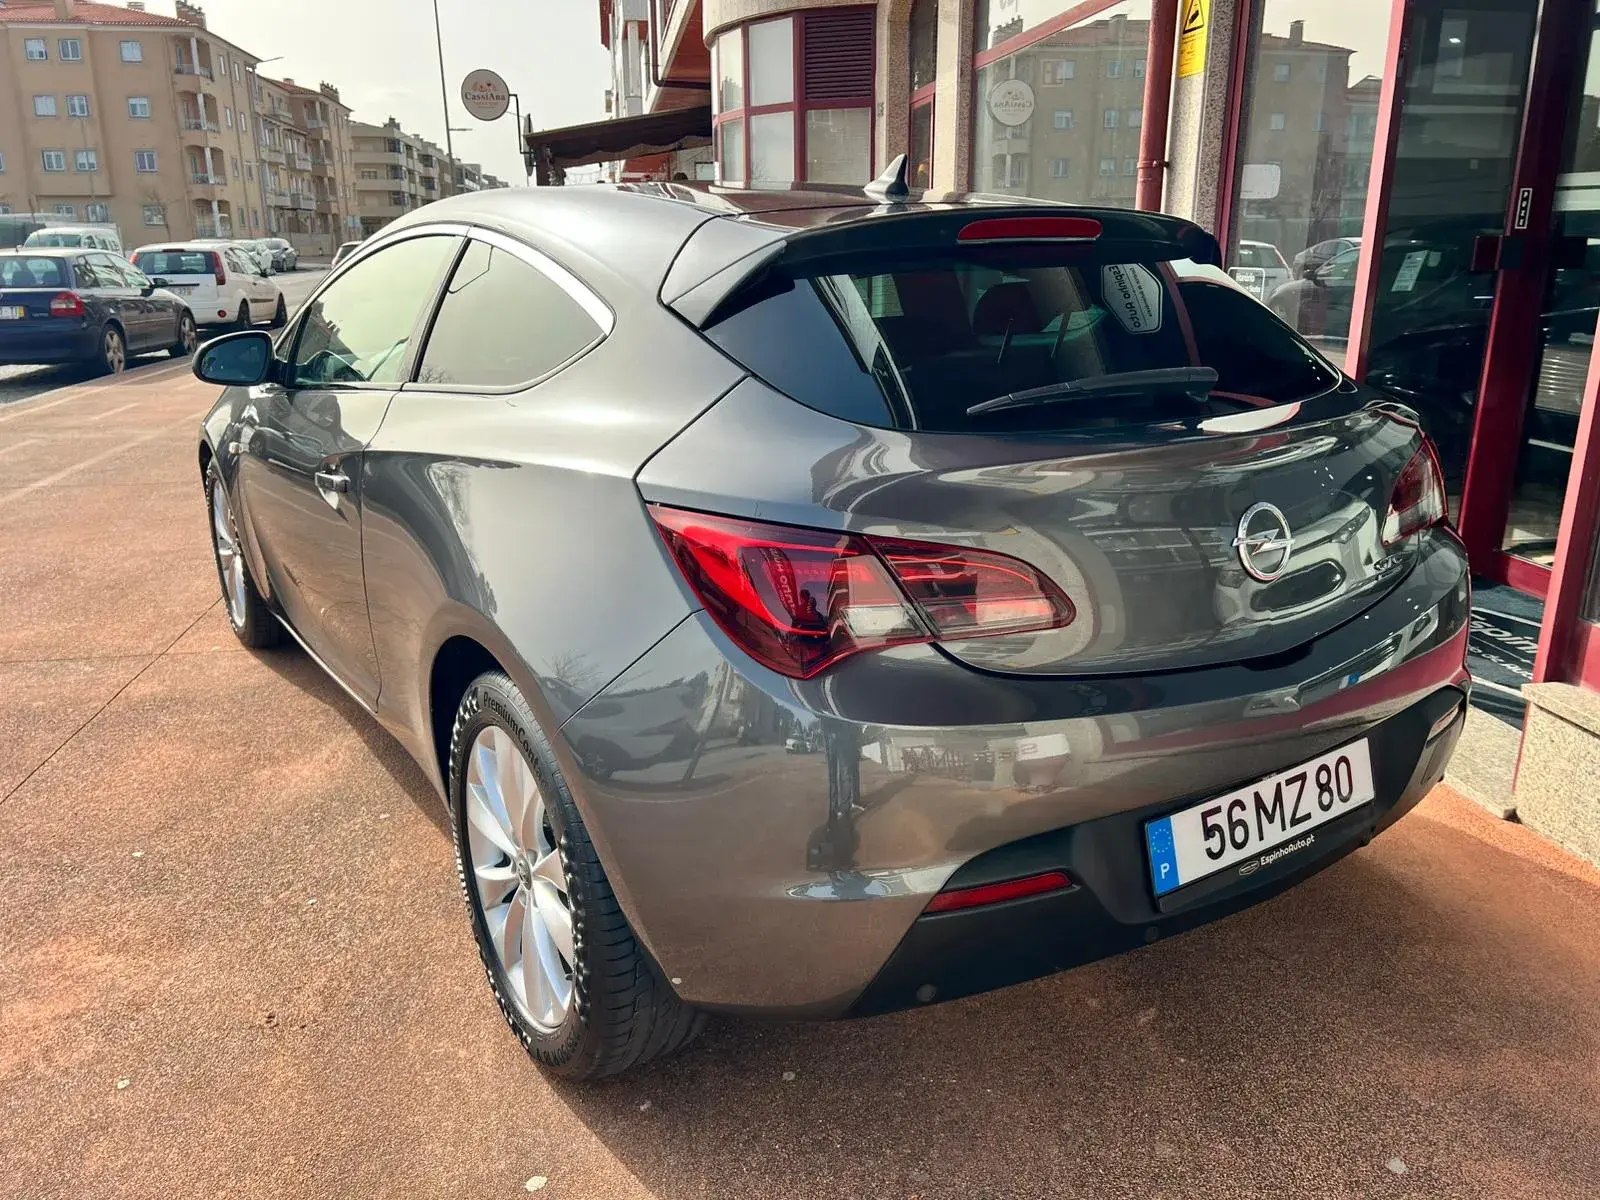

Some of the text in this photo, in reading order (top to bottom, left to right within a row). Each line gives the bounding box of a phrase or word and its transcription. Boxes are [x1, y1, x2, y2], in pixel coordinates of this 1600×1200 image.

[464, 91, 506, 101] CassiAna
[1260, 833, 1315, 866] EspinhoAuto.pt
[1160, 862, 1170, 879] P
